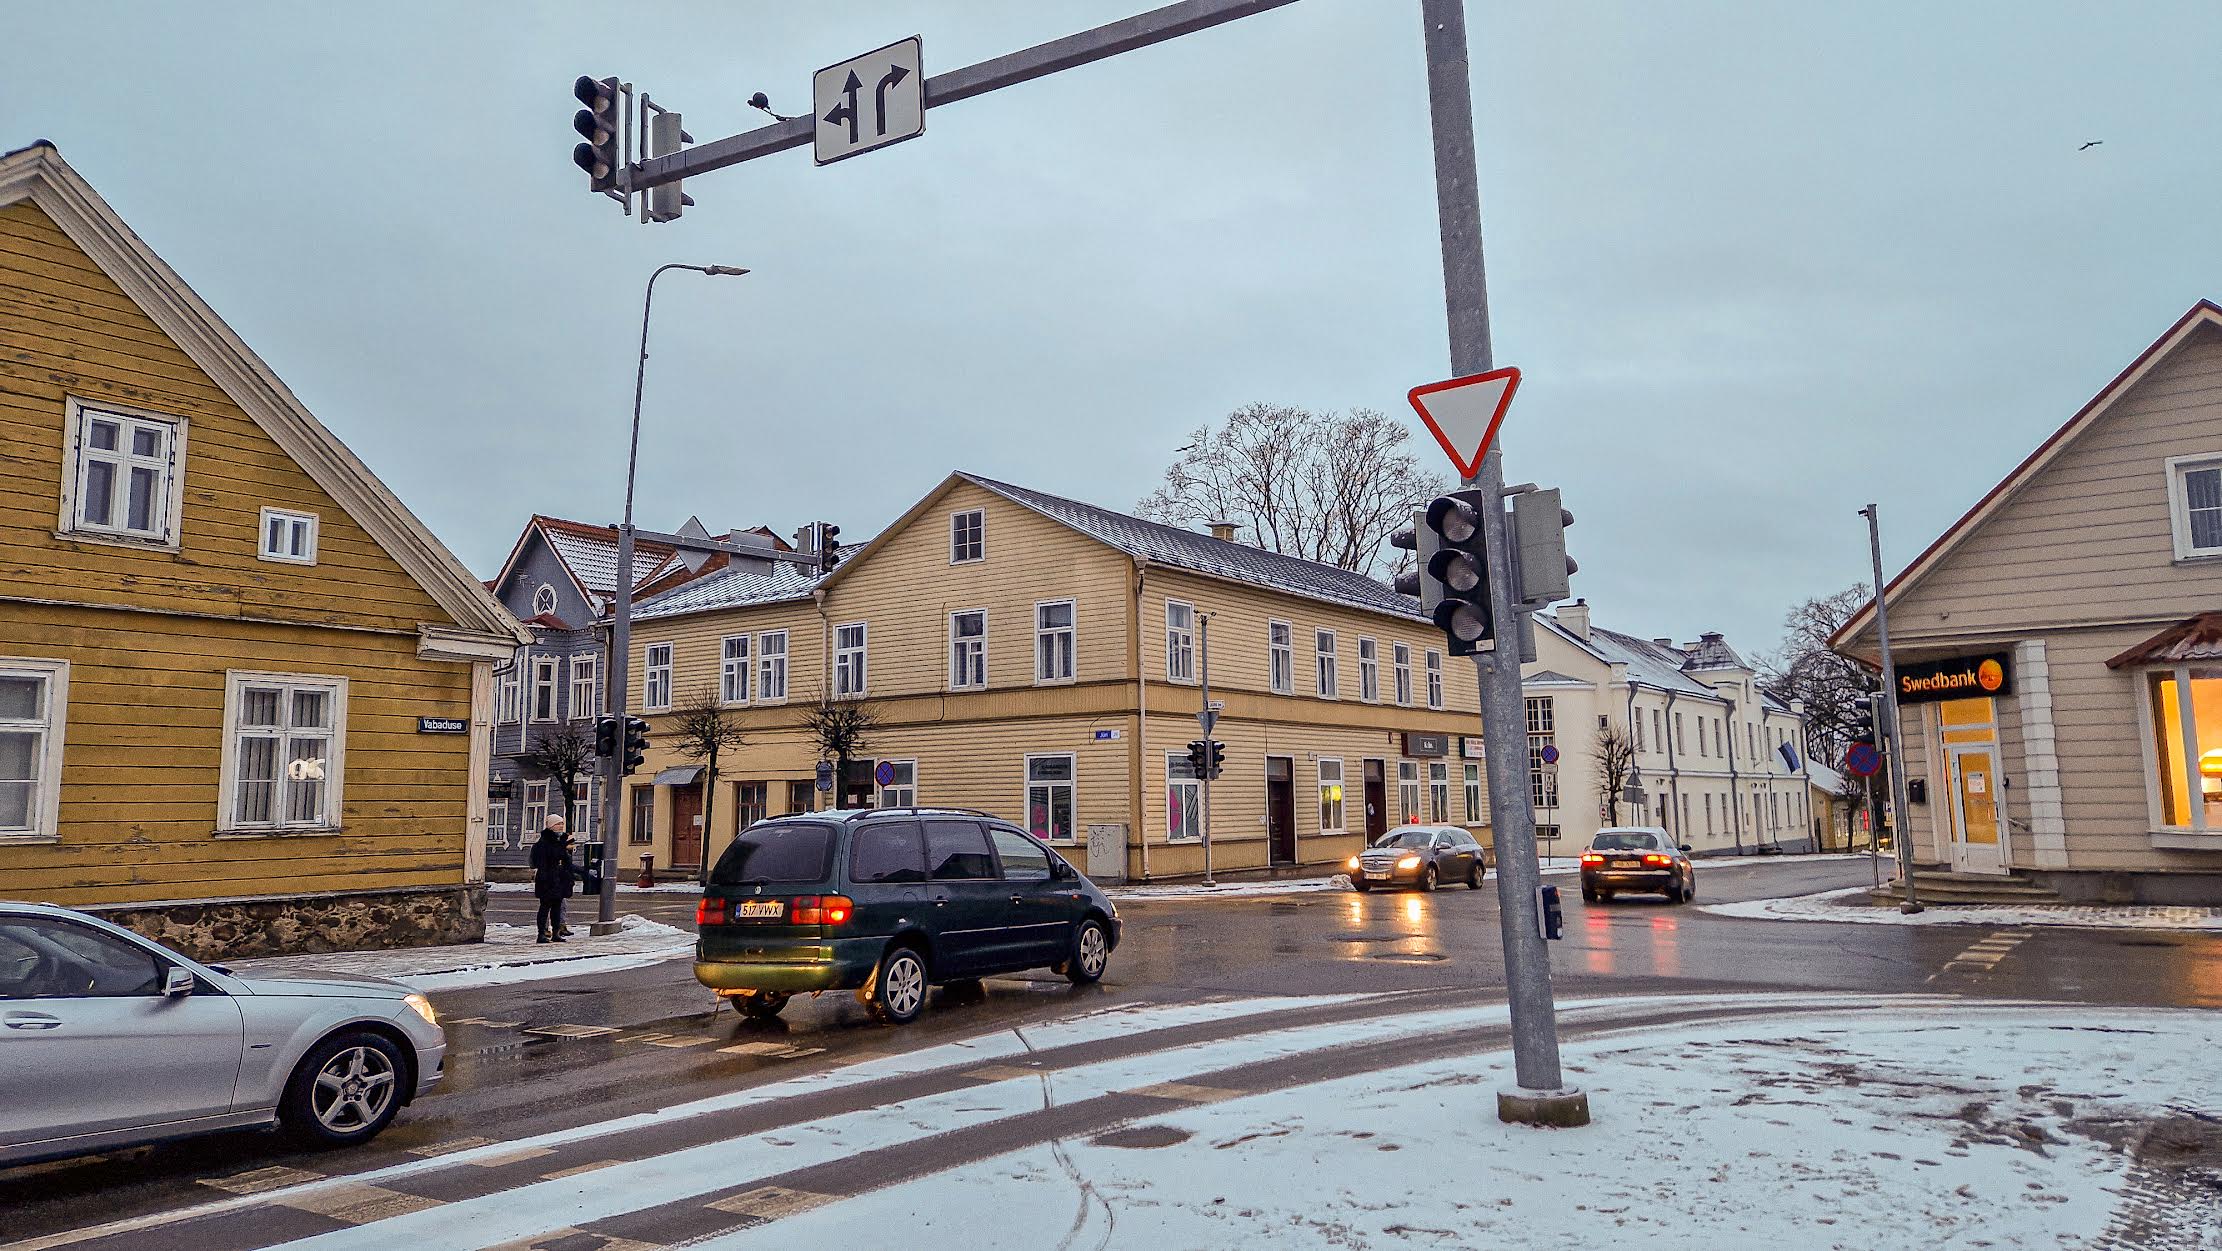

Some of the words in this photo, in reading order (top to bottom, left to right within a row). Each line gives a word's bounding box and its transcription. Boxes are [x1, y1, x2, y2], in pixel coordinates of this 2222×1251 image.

[1902, 668, 1977, 693] Swedbank
[423, 719, 463, 730] Vabaduse
[742, 905, 757, 916] 517
[758, 904, 780, 916] VWX
